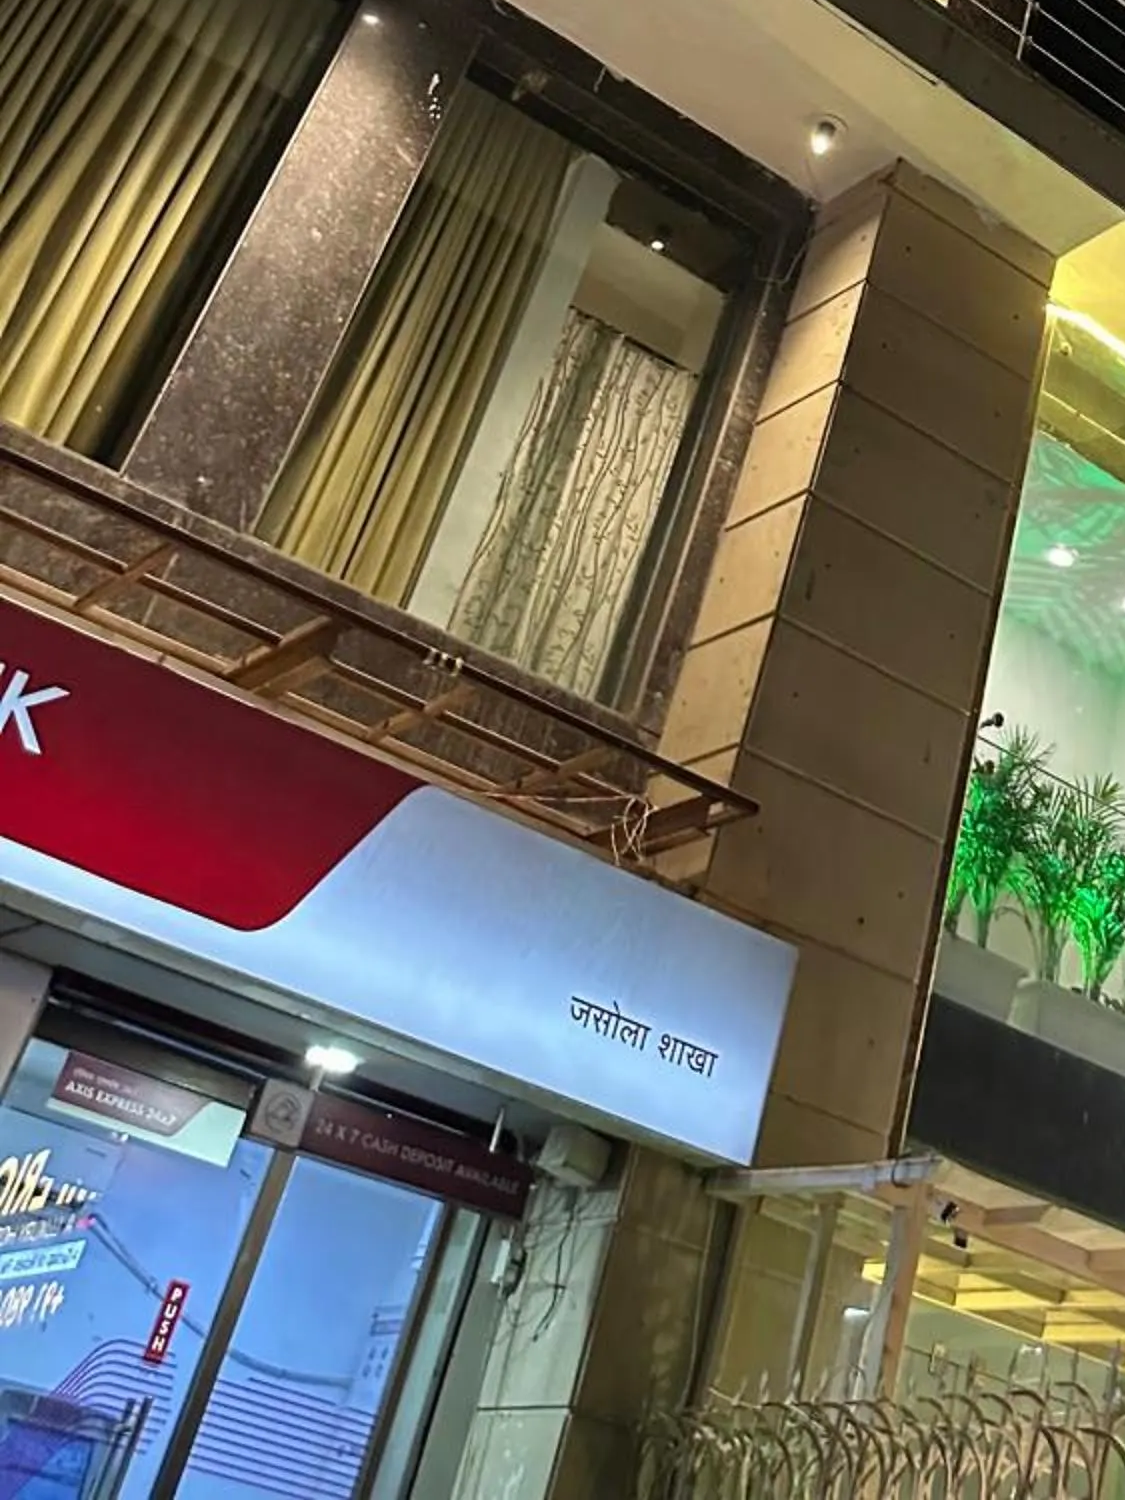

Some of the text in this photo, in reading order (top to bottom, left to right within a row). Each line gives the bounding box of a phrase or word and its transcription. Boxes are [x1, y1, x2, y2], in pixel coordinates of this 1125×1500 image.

[0, 662, 71, 755] K
[571, 996, 719, 1078] जसोला शाखा
[65, 1080, 95, 1100] AXIS
[315, 1118, 520, 1195] 24 X 7 CASH DEPOSIT AVAILABLE
[152, 1287, 182, 1352] PUSH
